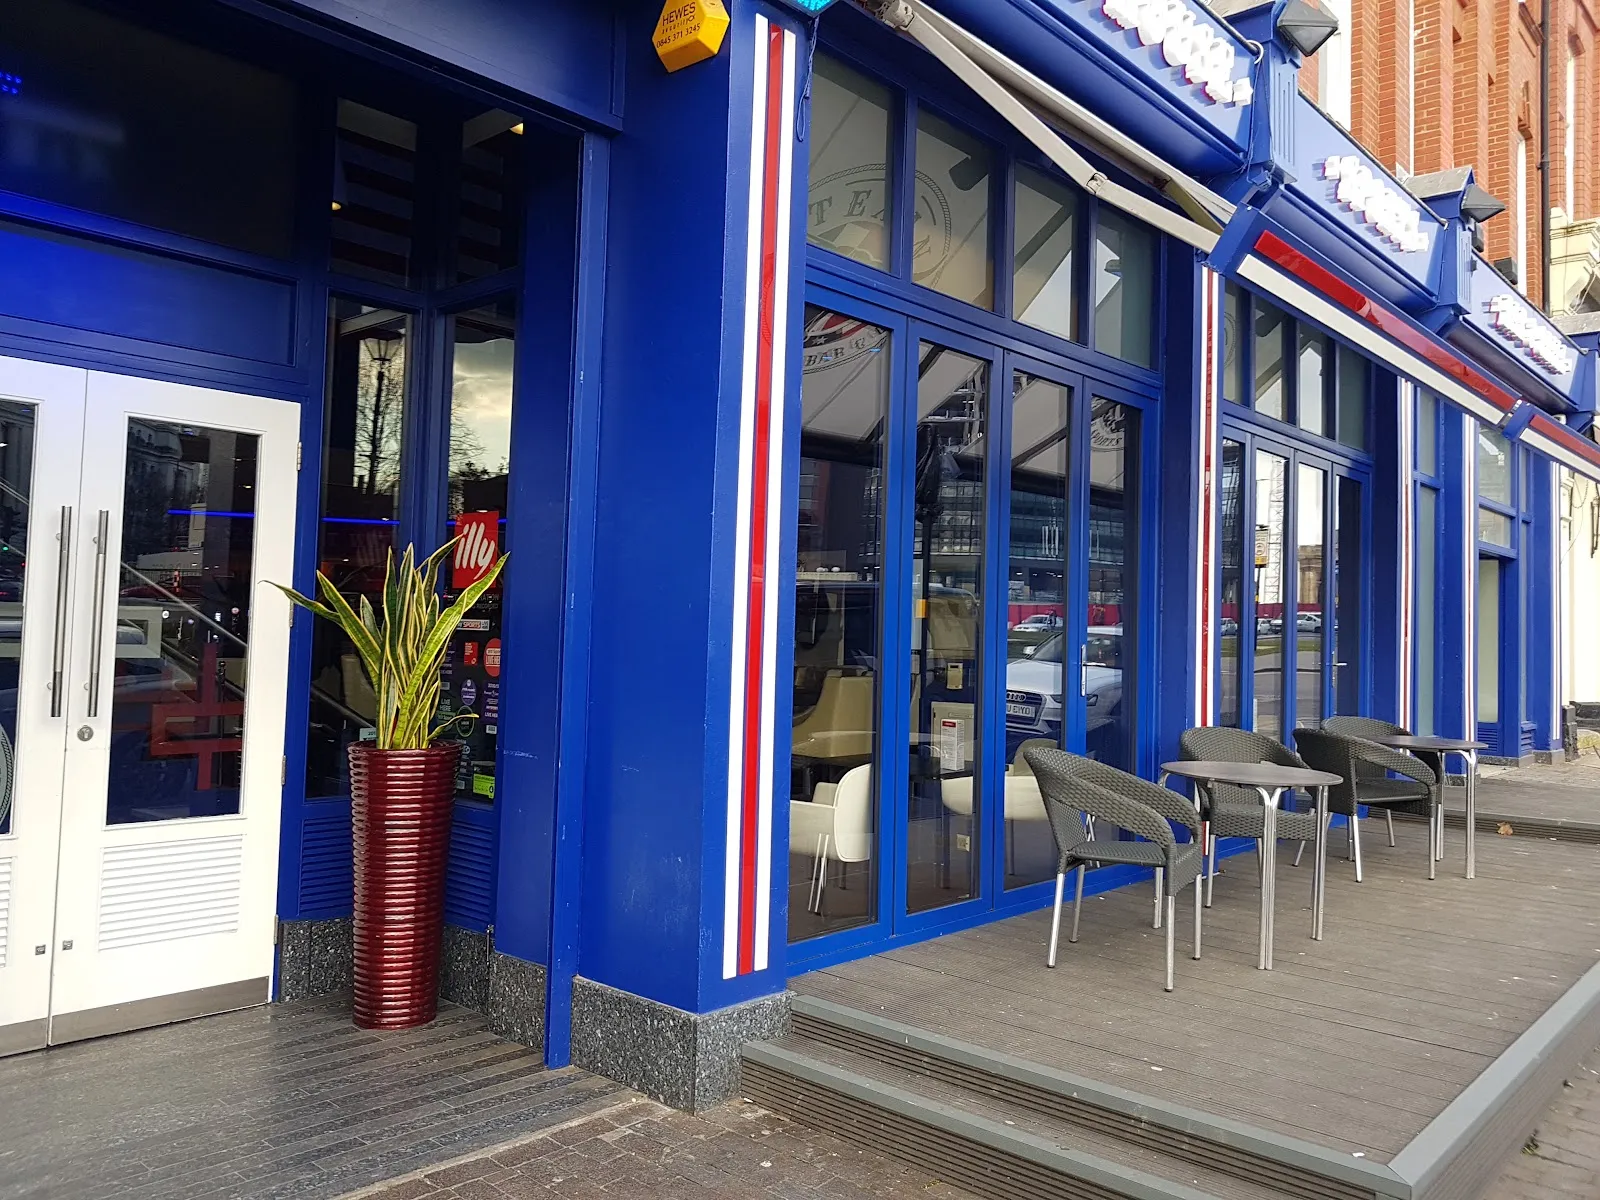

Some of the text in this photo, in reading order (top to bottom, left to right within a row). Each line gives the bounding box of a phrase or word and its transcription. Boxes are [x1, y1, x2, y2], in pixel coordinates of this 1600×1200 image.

[662, 2, 696, 26] HEWES
[656, 23, 701, 48] 0845 371 3245
[455, 521, 496, 580] illy
[463, 620, 481, 629] SPORTS
